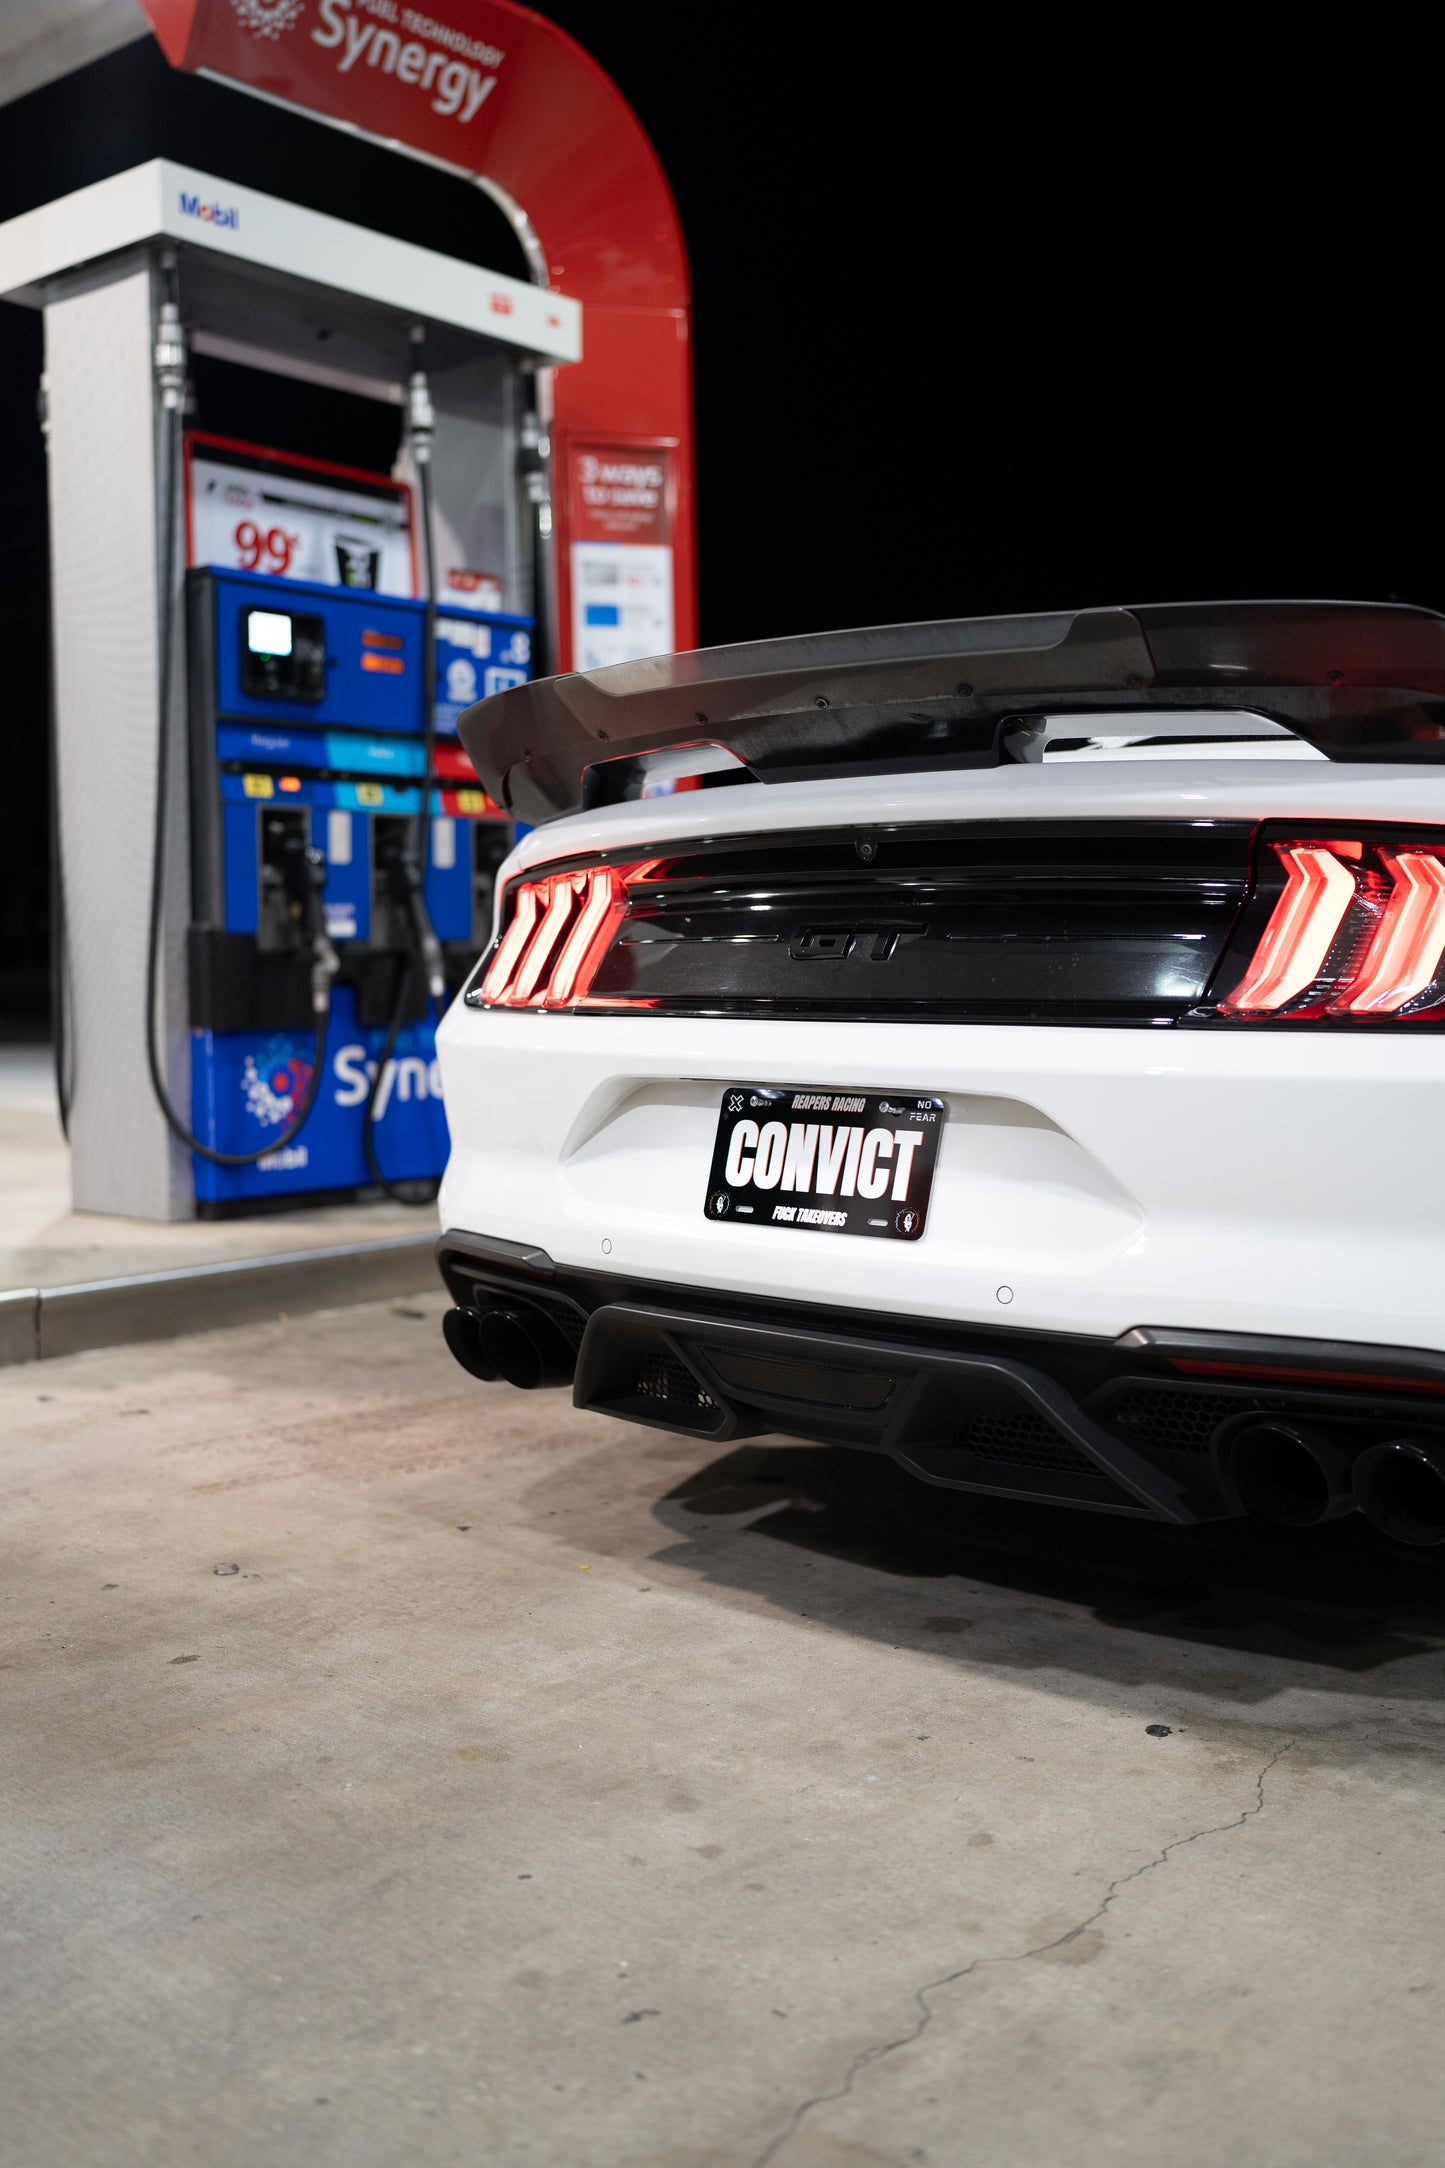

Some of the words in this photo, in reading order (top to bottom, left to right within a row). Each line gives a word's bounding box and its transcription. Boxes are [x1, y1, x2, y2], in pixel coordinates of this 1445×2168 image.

[401, 8, 505, 69] TECHNOLOGY
[311, 0, 497, 123] Synergy
[179, 192, 239, 230] Mobil
[788, 922, 929, 961] GT
[791, 1094, 831, 1111] REAPERS
[831, 1097, 867, 1113] RACING
[909, 1112, 937, 1122] FEAR
[917, 1100, 932, 1110] NO
[725, 1119, 925, 1202] CONVICT
[772, 1205, 797, 1221] FUCK
[796, 1208, 848, 1227] TAKEOVERS
